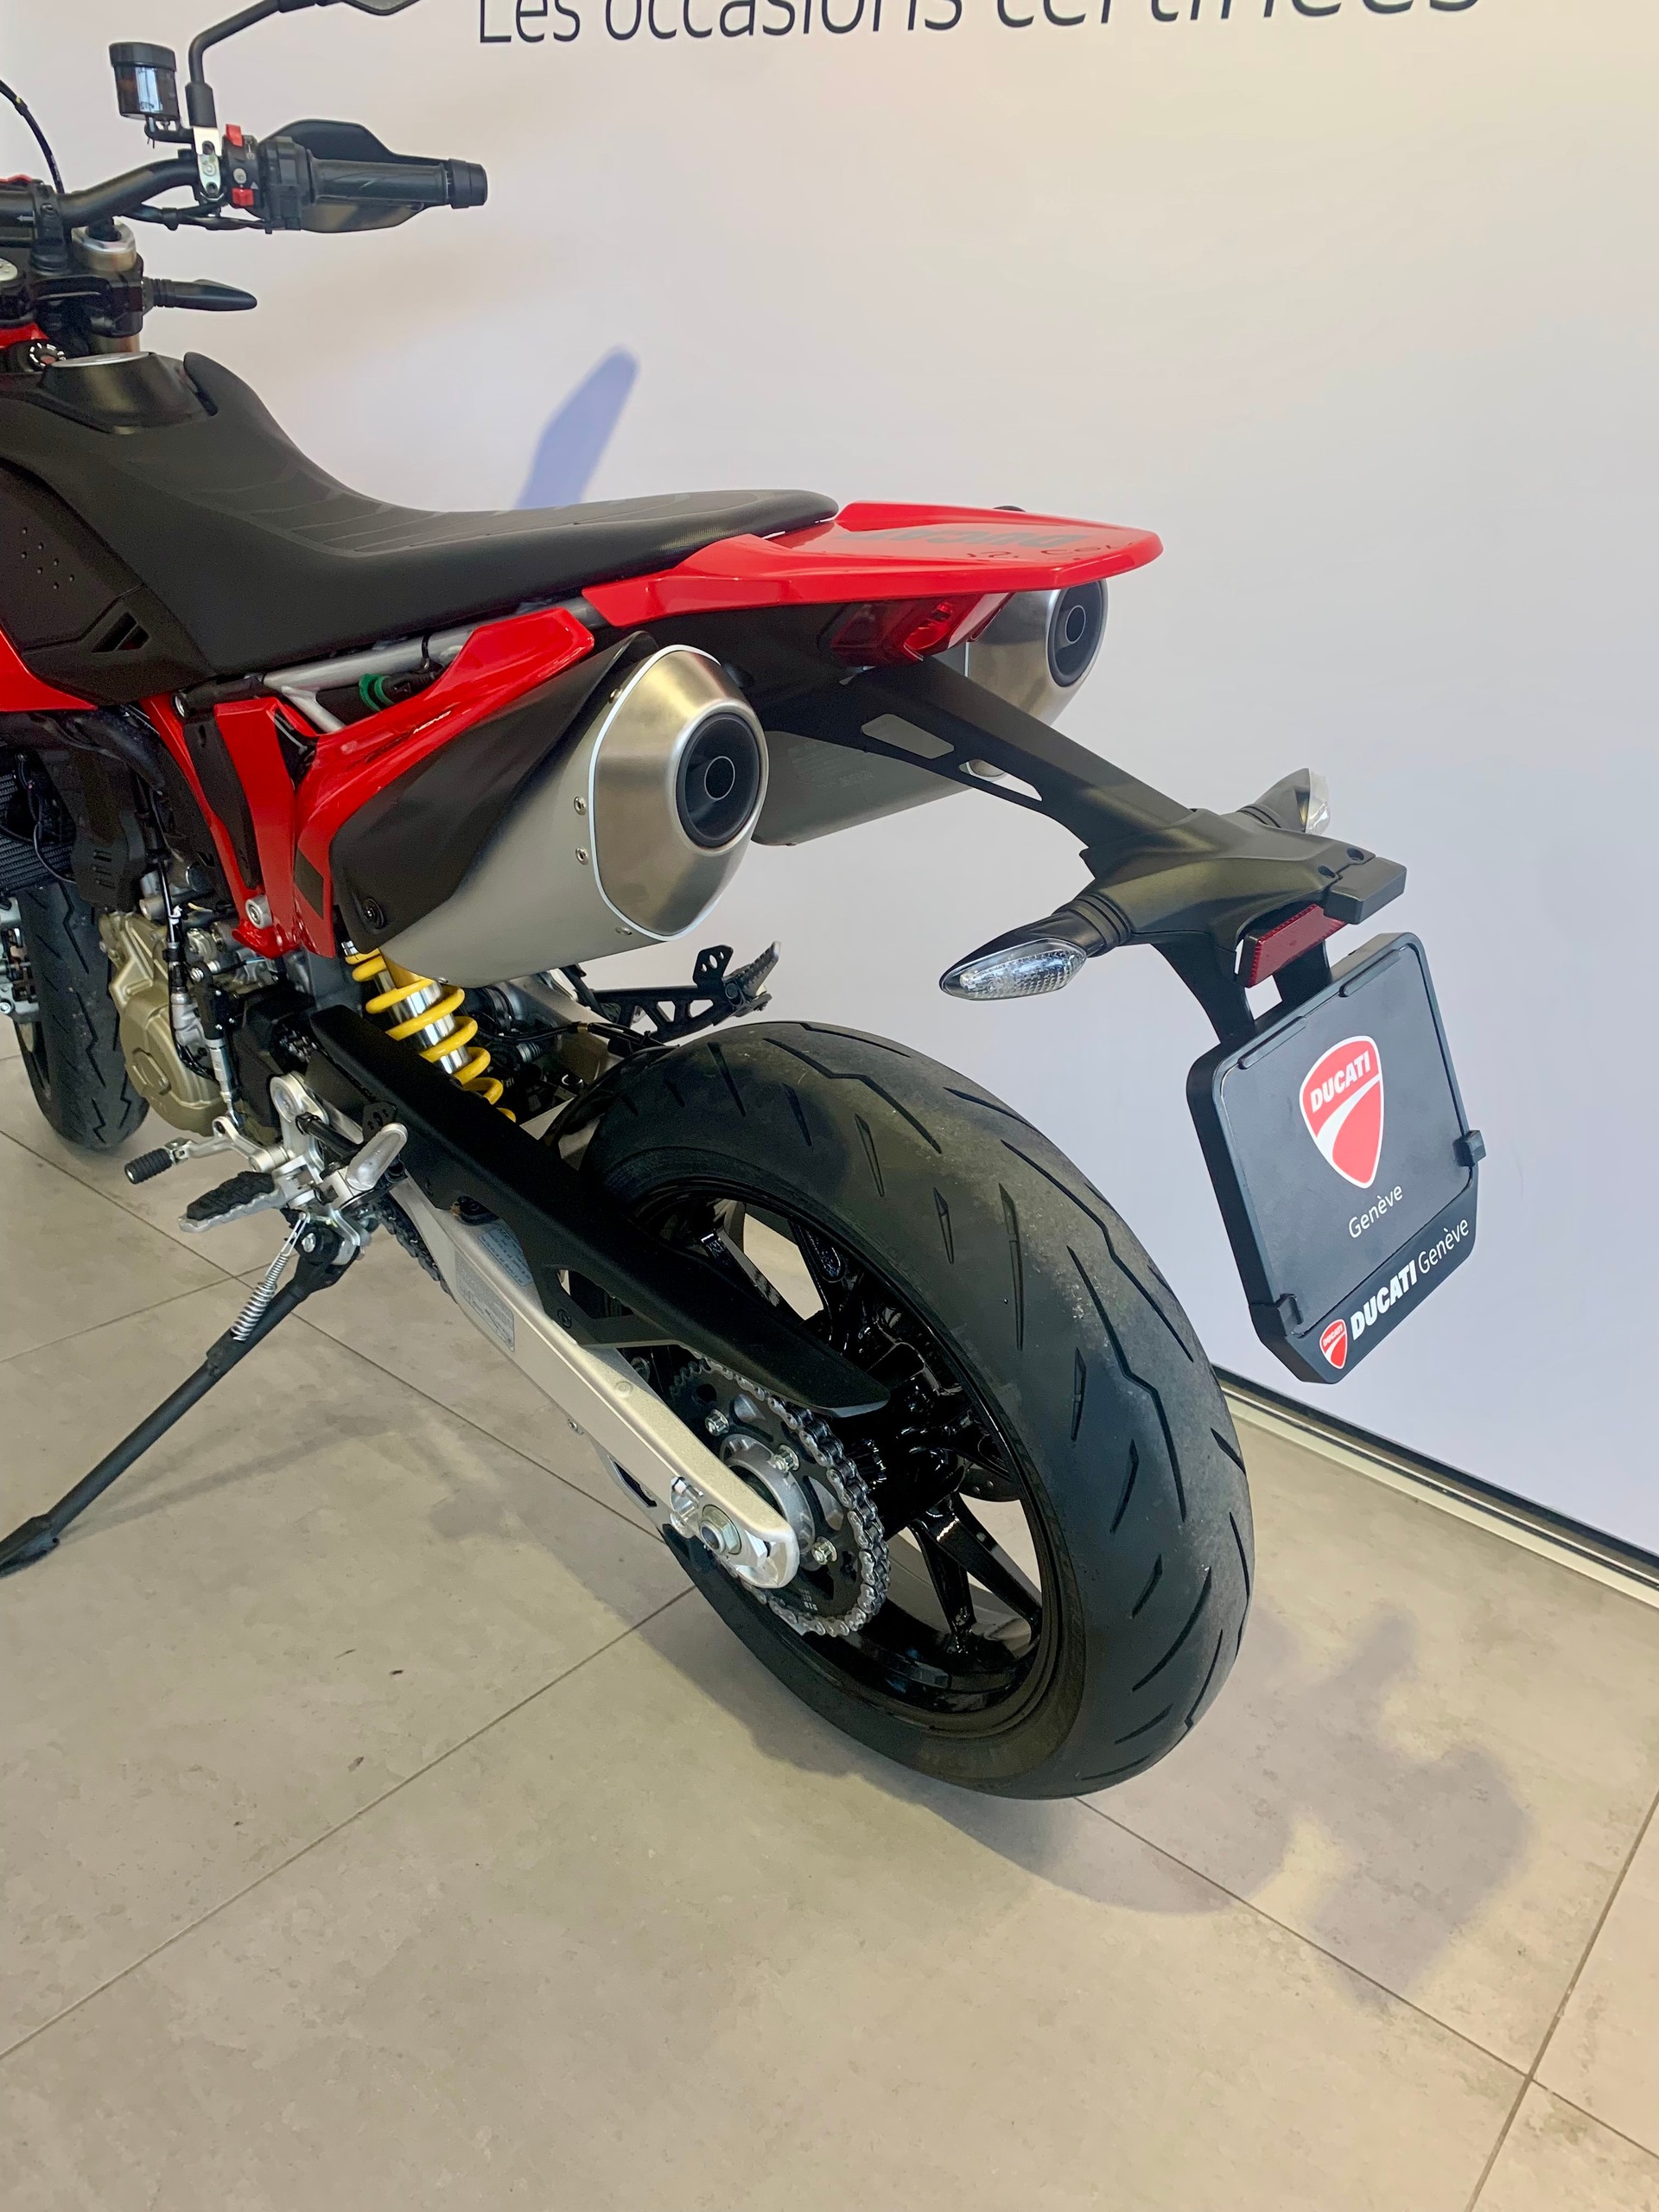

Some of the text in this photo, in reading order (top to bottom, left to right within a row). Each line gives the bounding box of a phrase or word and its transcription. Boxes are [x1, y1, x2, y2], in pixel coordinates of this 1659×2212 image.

[480, 0, 581, 42] Les
[1310, 1051, 1371, 1113] DUCATI
[1348, 1185, 1403, 1239] Genève
[1350, 1217, 1470, 1341] DUCATI Genève
[1322, 1323, 1344, 1347] DUCATI
